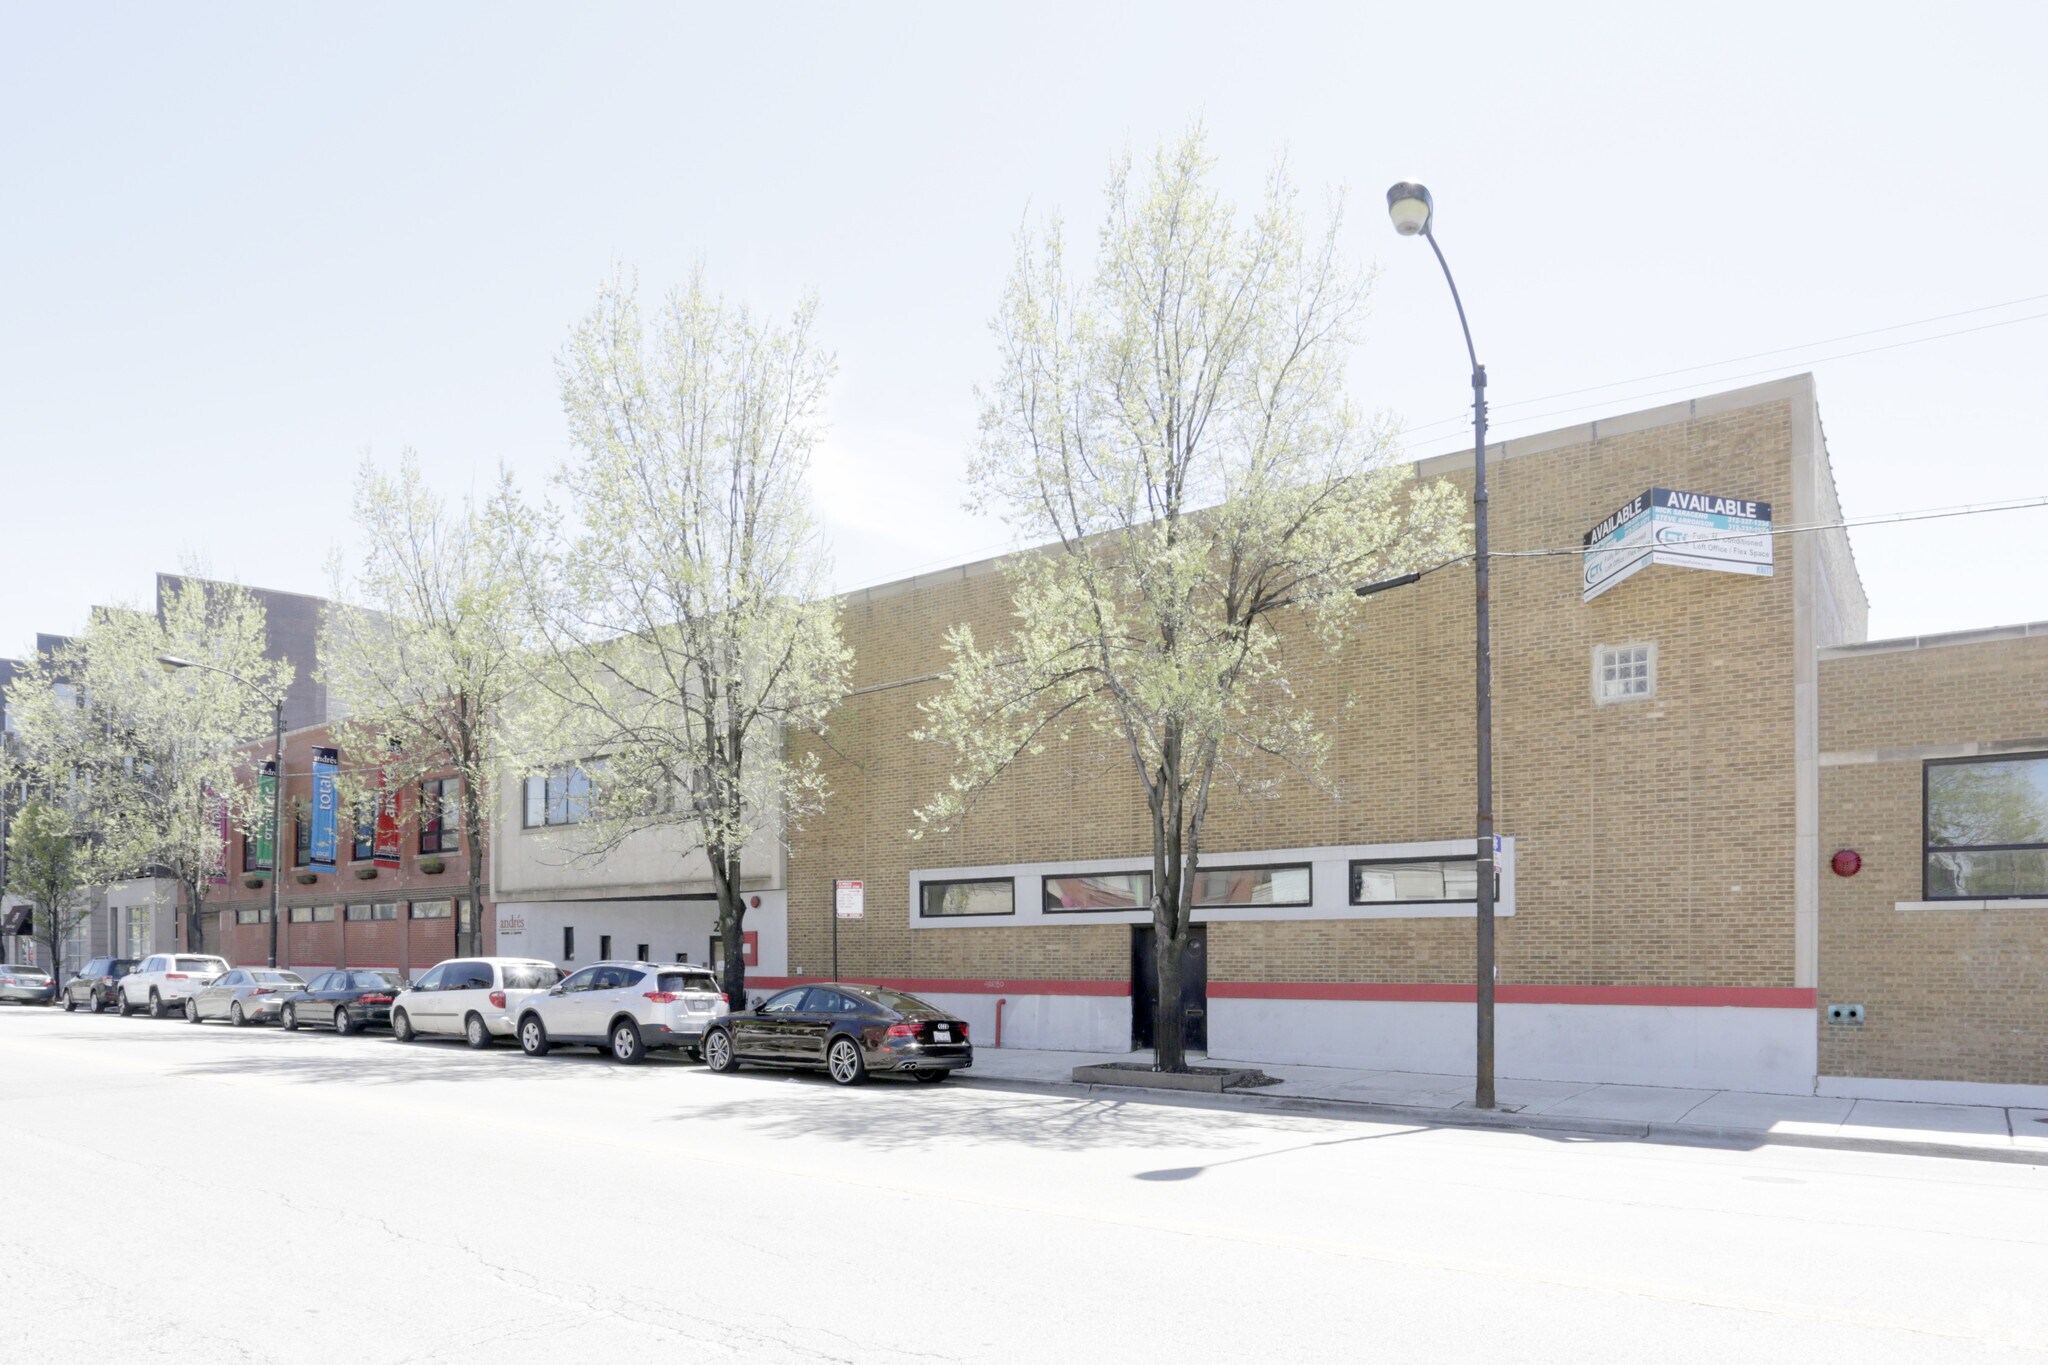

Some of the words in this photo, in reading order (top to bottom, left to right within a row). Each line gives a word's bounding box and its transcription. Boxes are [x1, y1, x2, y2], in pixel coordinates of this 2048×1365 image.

[1667, 491, 1757, 518] AVAILABLE
[1591, 496, 1643, 545] AVAILABLE
[1693, 542, 1706, 551] Loft
[1708, 544, 1728, 553] Office
[1733, 547, 1747, 555] Flex
[1749, 549, 1770, 558] Space
[313, 754, 338, 766] andrés
[319, 774, 332, 811] total
[499, 914, 525, 929] andrés
